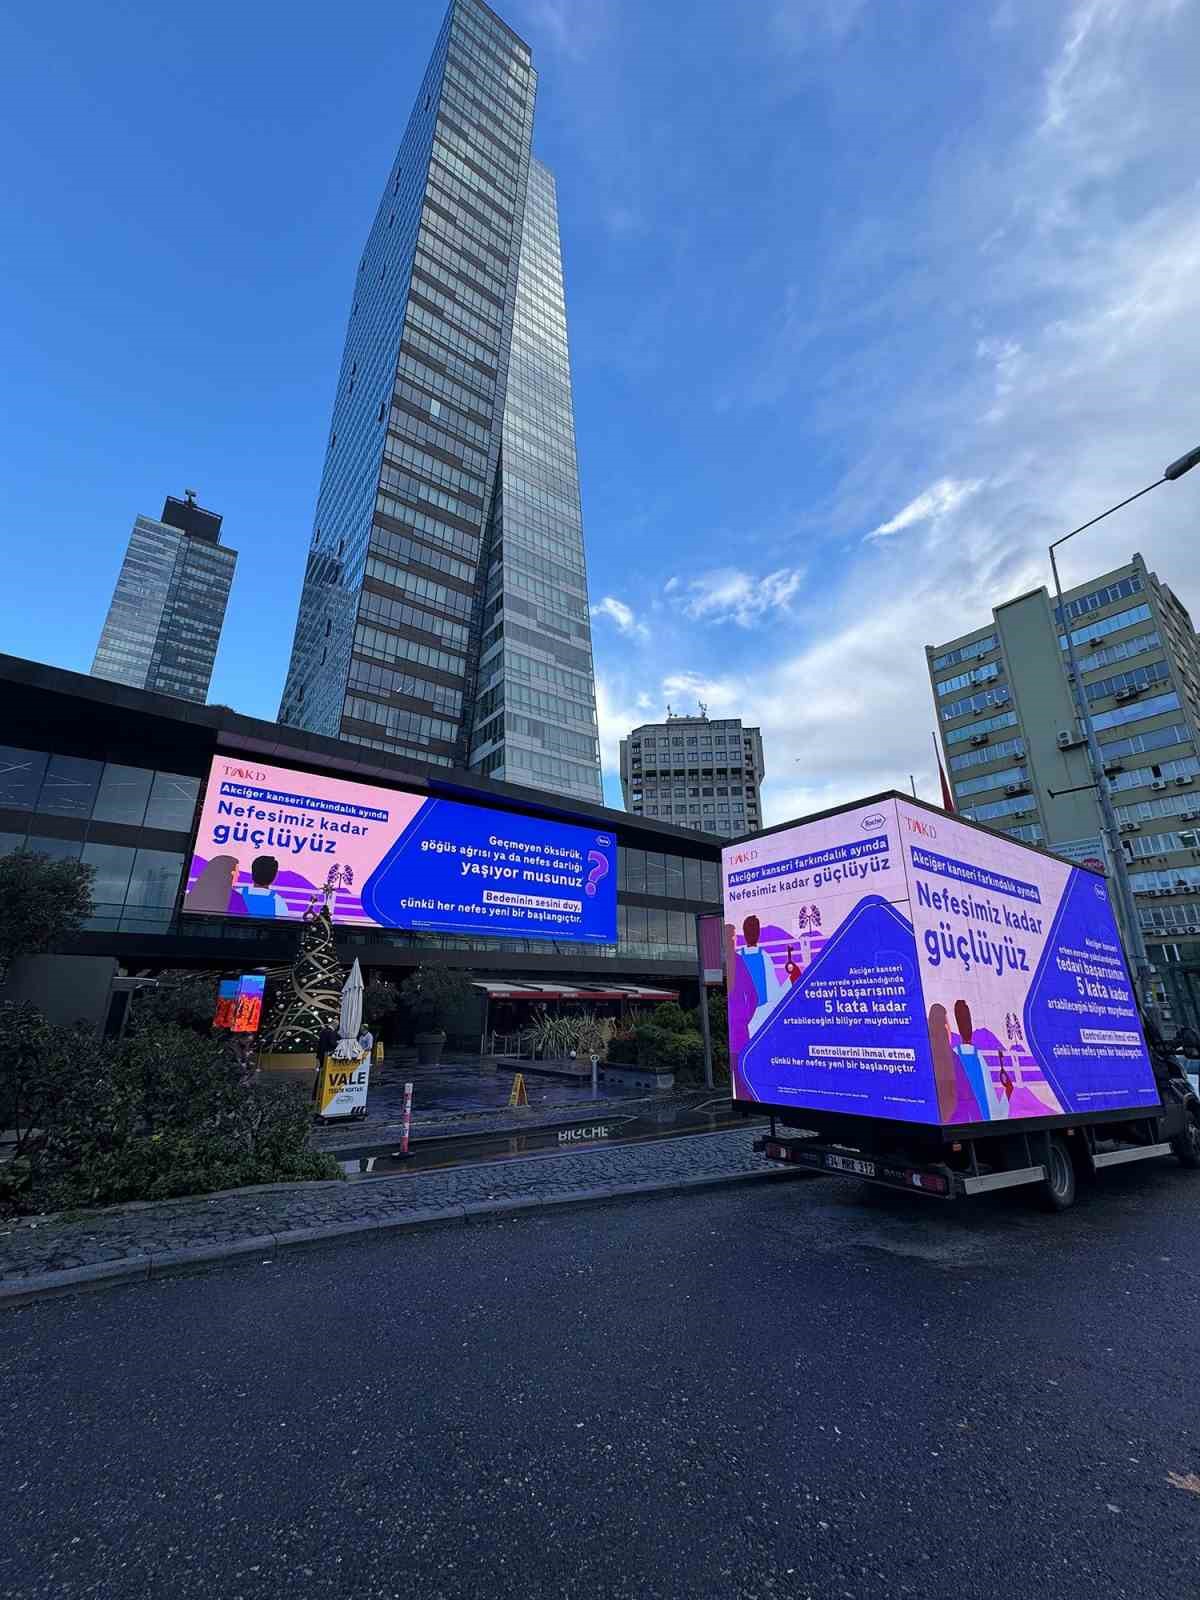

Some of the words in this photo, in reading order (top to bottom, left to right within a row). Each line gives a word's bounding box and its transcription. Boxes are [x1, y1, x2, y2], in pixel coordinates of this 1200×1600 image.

[222, 784, 264, 798] Akciğer
[266, 792, 303, 805] kanseri
[305, 799, 356, 814] farkındalık
[358, 808, 387, 820] ayında
[218, 800, 314, 828] Nefesimiz
[320, 817, 368, 836] kadar
[213, 822, 336, 854] güçlüyüz
[489, 835, 541, 853] Geçmeyen
[421, 839, 456, 852] göğüs
[460, 845, 491, 858] ağrısı
[493, 851, 506, 861] ya
[509, 852, 521, 862] da
[524, 855, 550, 867] nefes
[553, 858, 582, 873] darlığı
[729, 870, 760, 884] Akciğer
[761, 862, 793, 876] kanseri
[795, 849, 847, 868] farkındalık
[850, 839, 887, 857] ayında
[461, 861, 519, 879] yaşıyor
[523, 869, 582, 887] musunuz
[729, 883, 776, 902] Nefesimiz
[779, 877, 810, 892] kadar
[813, 857, 890, 887] güçlüyüz
[912, 851, 945, 870] Akciğer
[947, 862, 976, 879] kanseri
[978, 872, 1016, 891] farkındalık
[401, 897, 434, 909] çünkü
[437, 900, 454, 911] her
[458, 903, 487, 914] nefes
[489, 906, 510, 917] yeni
[512, 908, 525, 918] bir
[527, 910, 582, 924] başlangıçtır.
[486, 892, 533, 905] Bedeninin
[535, 898, 560, 908] sesini
[916, 880, 1001, 925] Nefesimiz
[1003, 904, 1042, 935] kadar
[925, 921, 1029, 976] güçlüyüz
[1056, 957, 1083, 974] tedavi
[805, 987, 837, 998] tedavi
[840, 985, 905, 999] başarısının
[1076, 976, 1084, 996] 5
[1085, 977, 1109, 998] kata
[1108, 985, 1129, 1001] kadar
[824, 1000, 833, 1013] 5
[836, 1000, 868, 1013] kata
[872, 1001, 907, 1012] kadar
[783, 1015, 835, 1026] artabileceğini
[836, 1016, 861, 1026] biliyor
[770, 1056, 791, 1066] çünkü
[792, 1057, 804, 1065] her
[805, 1058, 826, 1067] nefes
[828, 1060, 845, 1070] yeni
[847, 1060, 858, 1069] bir
[860, 1061, 916, 1074] başlangıçtır.
[811, 1047, 860, 1057] Kontrollerini
[862, 1048, 886, 1057] ihmal
[329, 1072, 366, 1086] VALE
